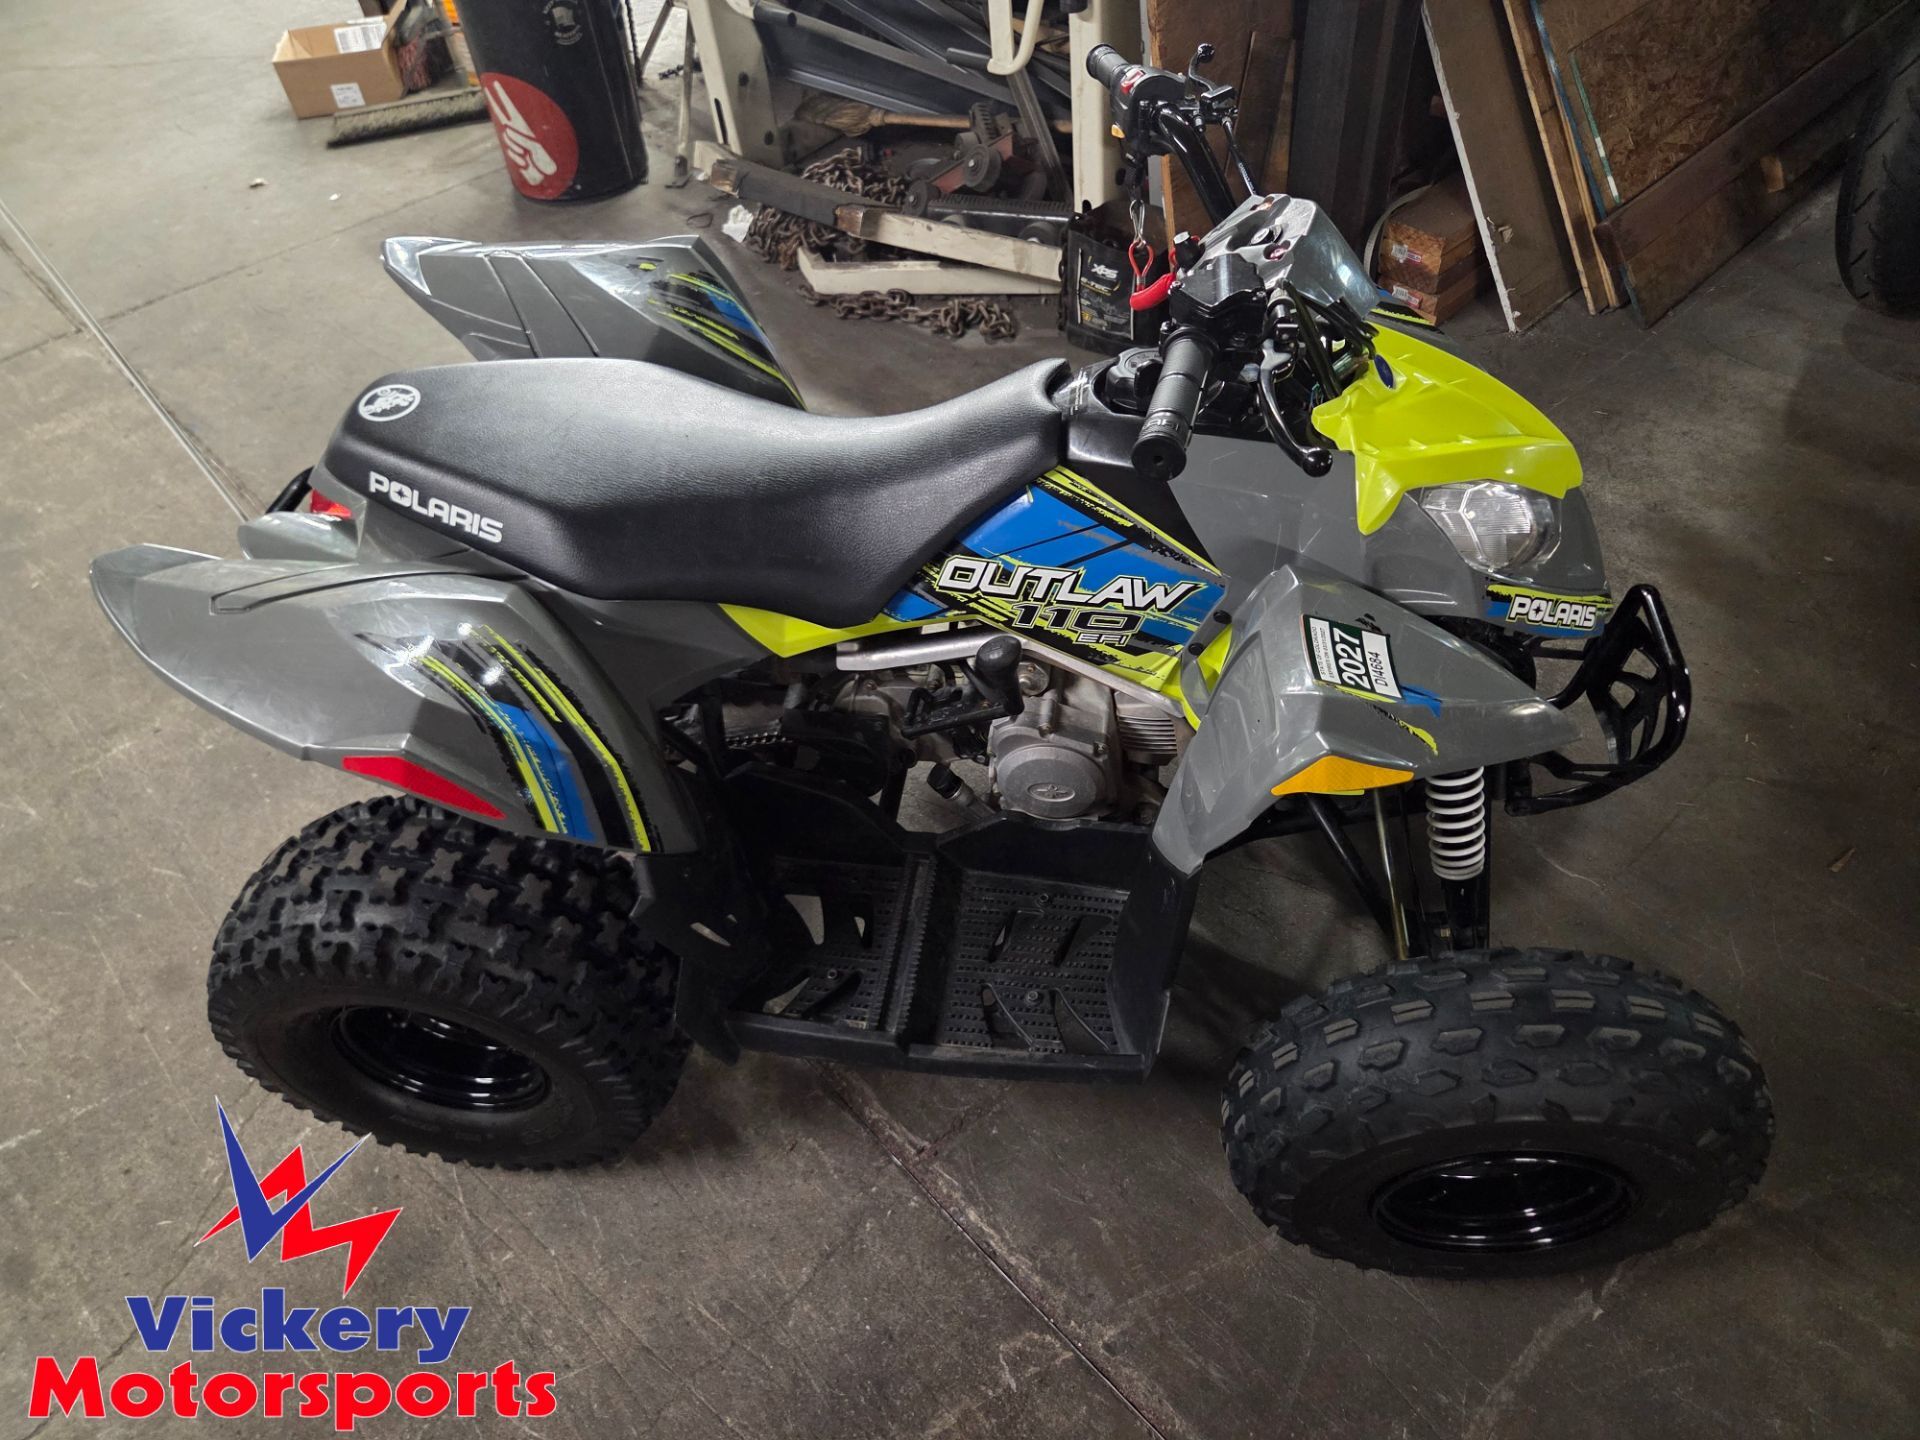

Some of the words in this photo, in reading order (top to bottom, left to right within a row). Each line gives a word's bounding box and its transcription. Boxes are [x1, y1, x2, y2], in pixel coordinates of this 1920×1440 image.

[369, 471, 503, 543] POLARIS
[938, 558, 1202, 611] OUTLAW
[1011, 603, 1145, 634] 110
[1509, 596, 1597, 628] POLARIS
[1074, 633, 1128, 647] EFI
[1333, 627, 1371, 689] 2027
